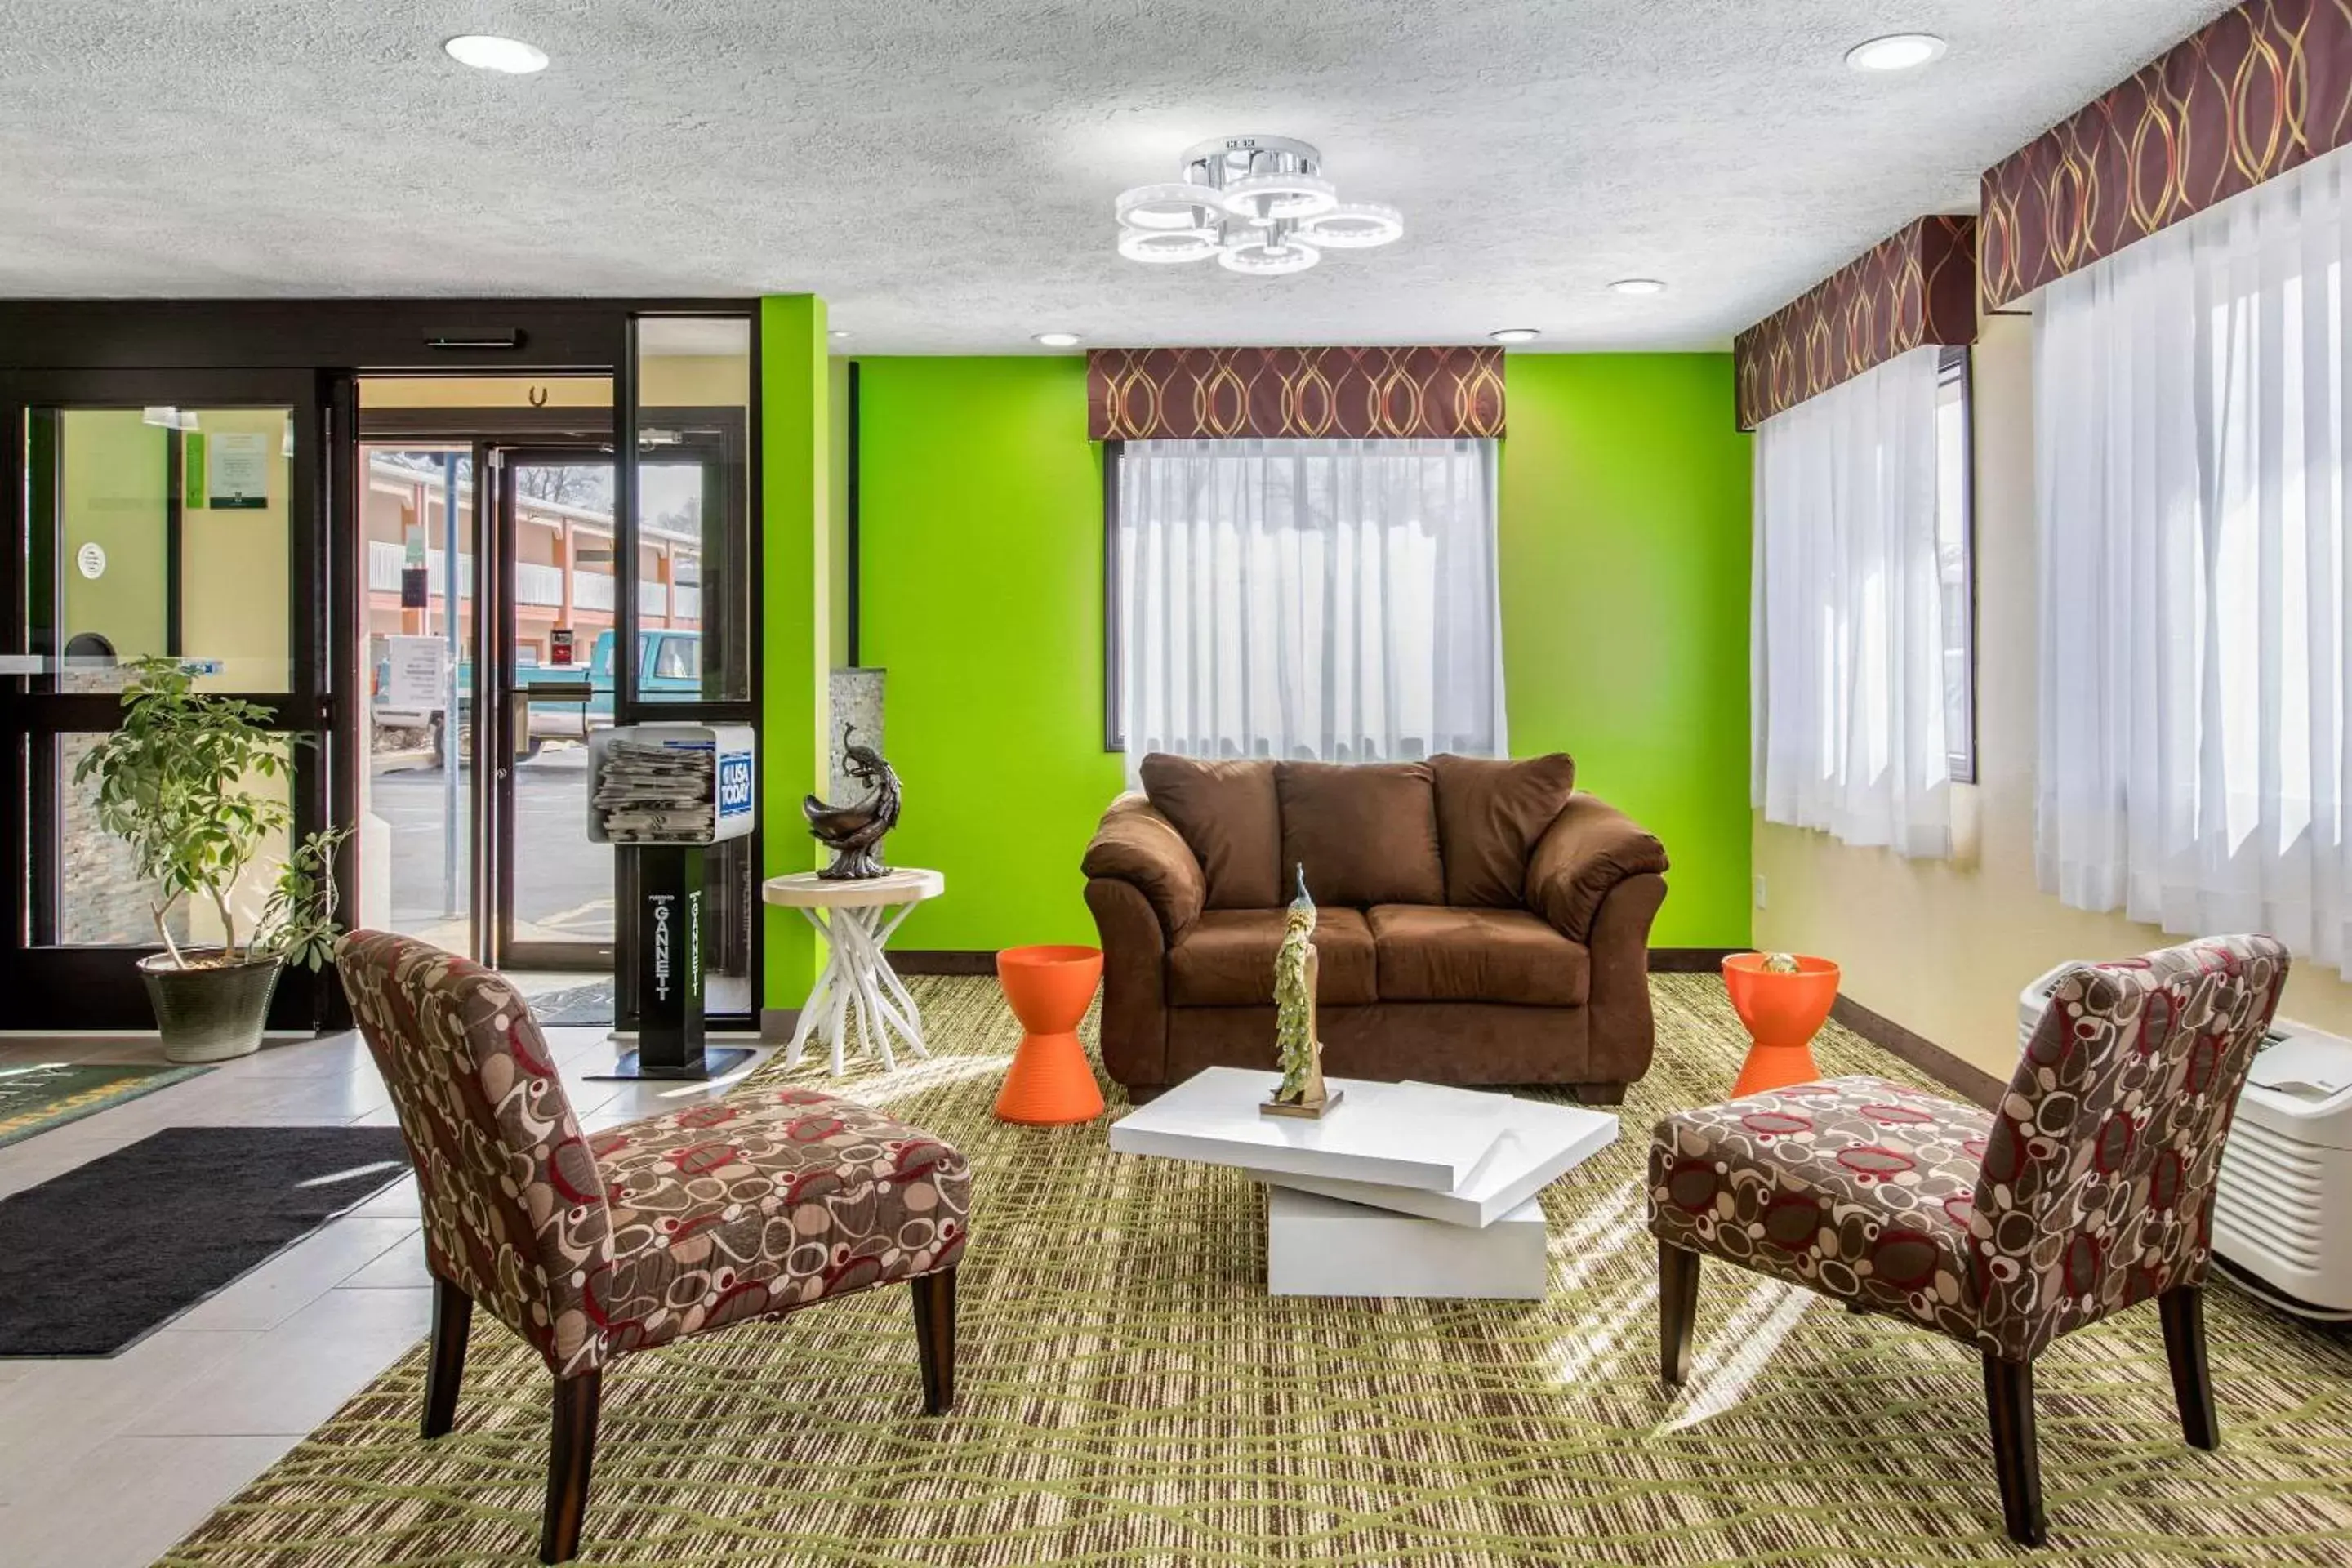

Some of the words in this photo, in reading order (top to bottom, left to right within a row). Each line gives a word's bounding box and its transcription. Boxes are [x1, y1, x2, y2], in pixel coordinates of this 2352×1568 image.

[731, 762, 750, 784] USA
[721, 783, 749, 806] TODAY
[654, 906, 670, 1001] GANNETT
